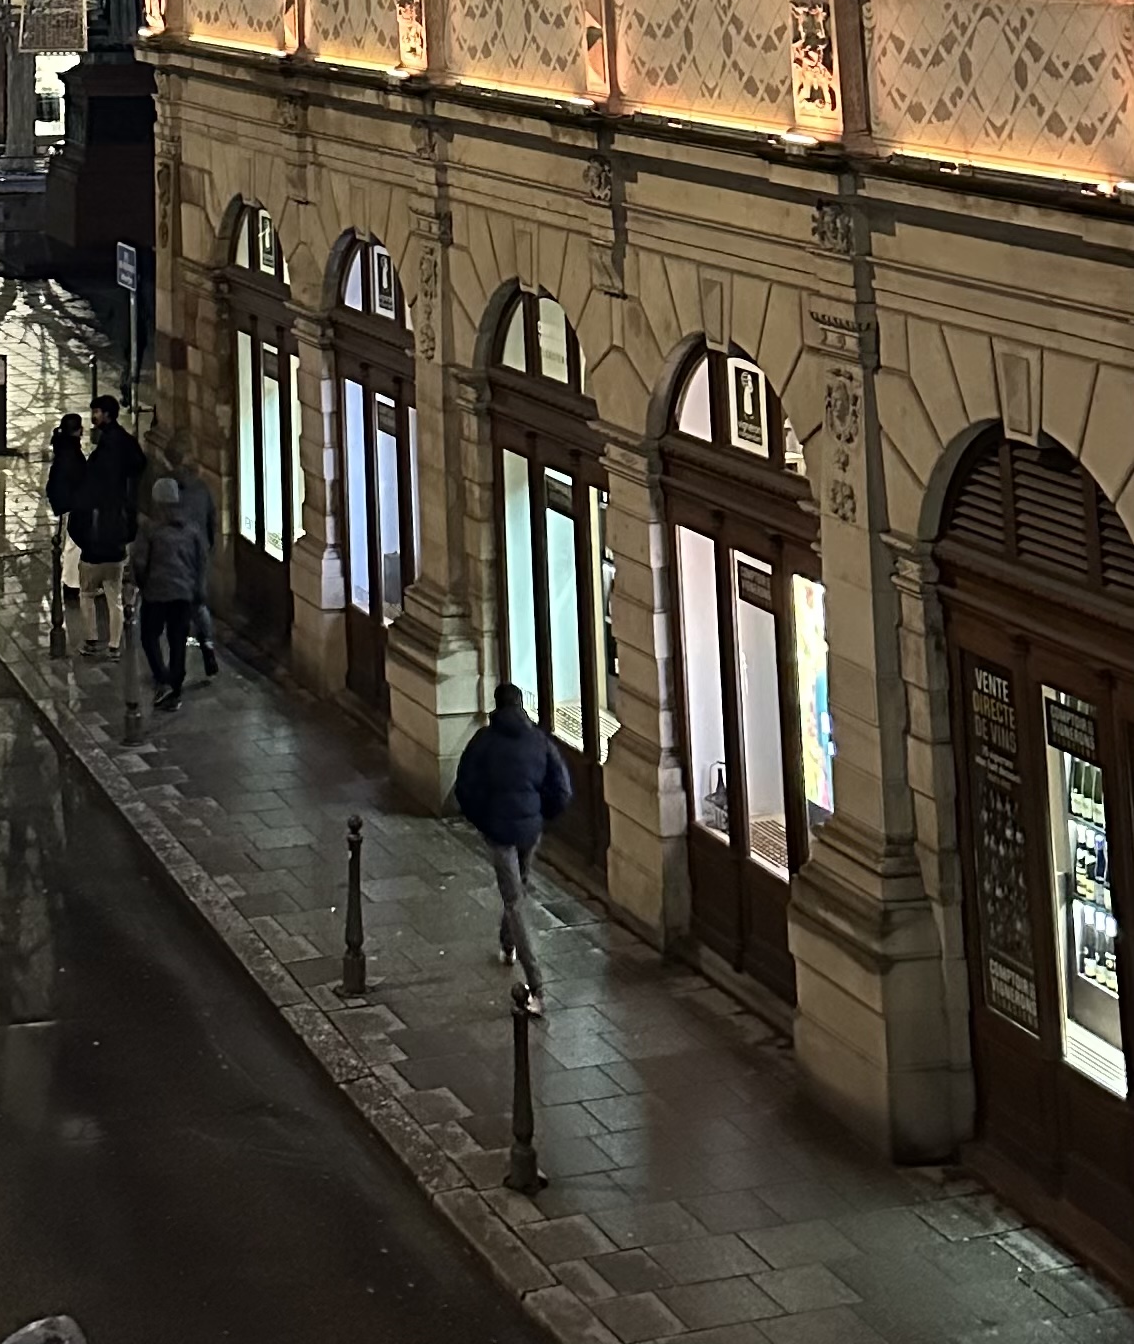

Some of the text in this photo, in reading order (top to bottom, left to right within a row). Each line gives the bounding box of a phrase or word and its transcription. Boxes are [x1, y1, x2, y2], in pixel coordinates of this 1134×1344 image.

[974, 667, 1009, 703] VENTE
[972, 689, 1015, 730] DIRECTE
[974, 714, 1017, 753] DE VINS
